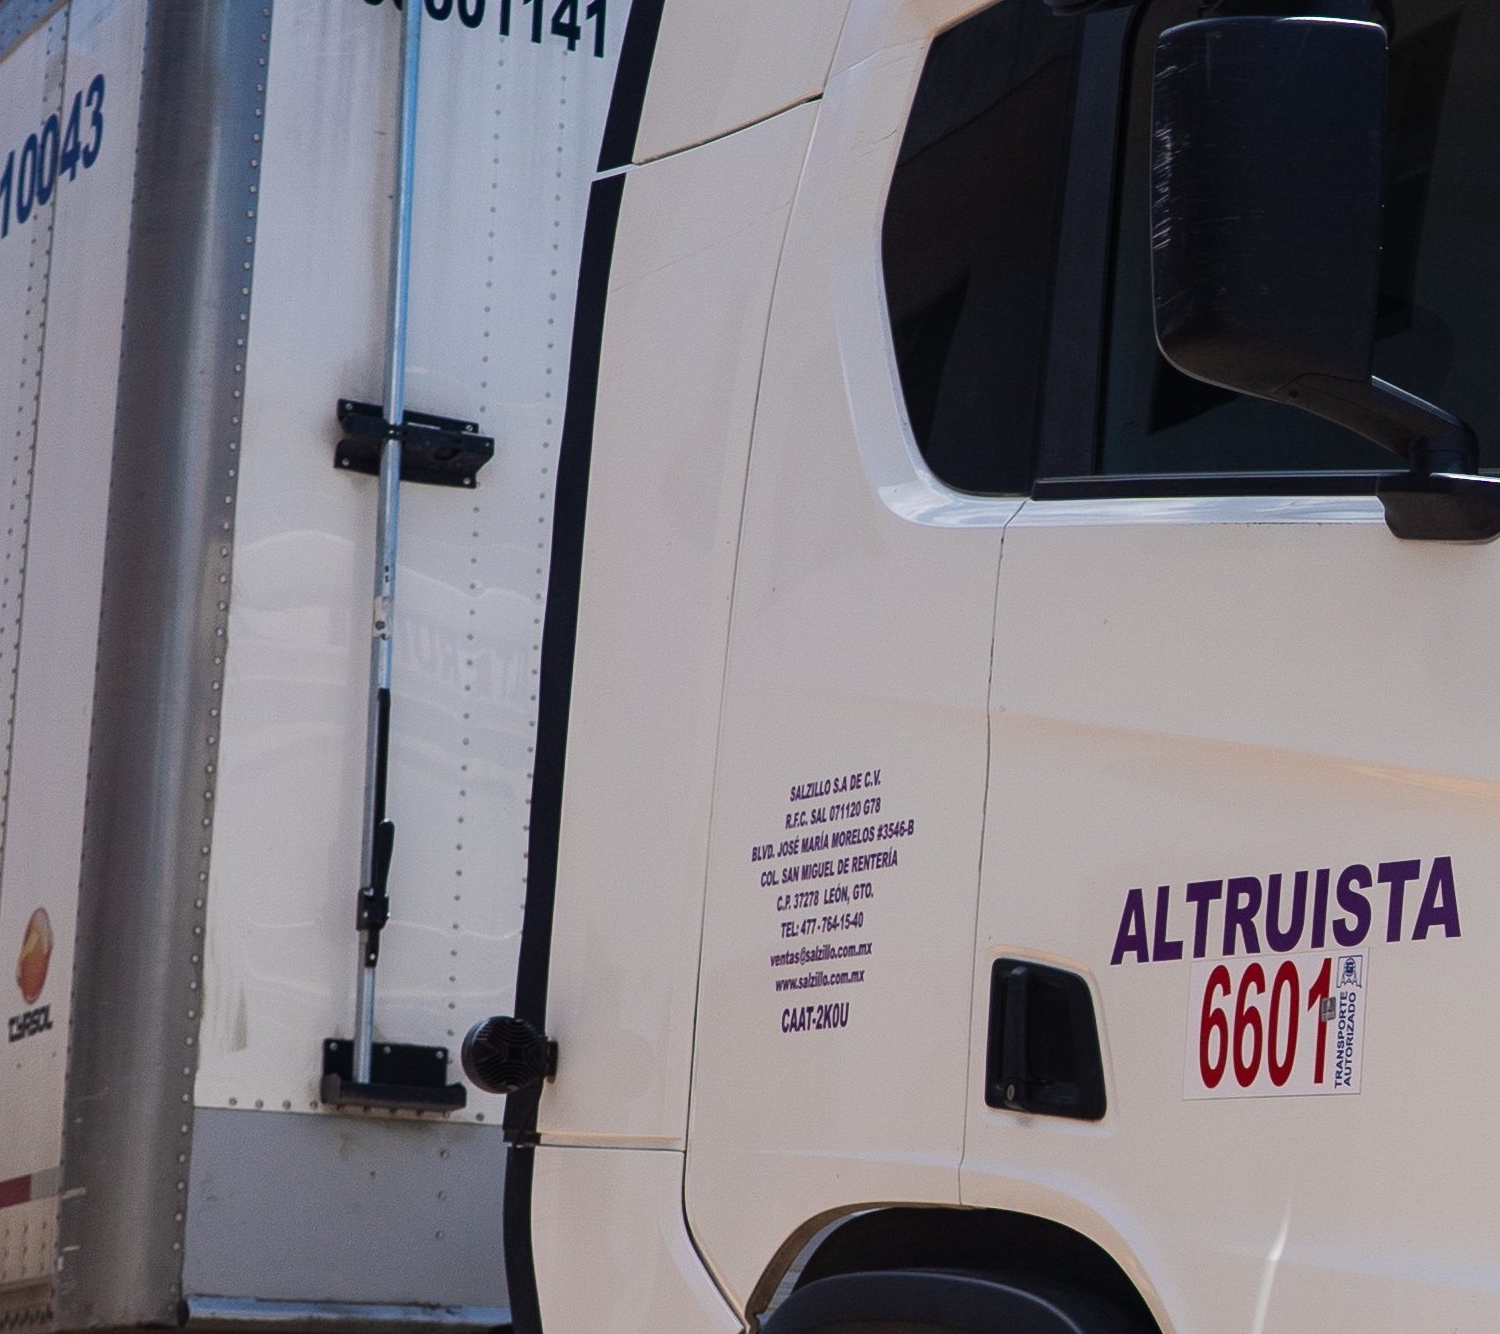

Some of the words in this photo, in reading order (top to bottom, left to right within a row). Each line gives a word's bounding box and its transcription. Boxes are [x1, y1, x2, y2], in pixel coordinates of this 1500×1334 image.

[789, 779, 831, 802] SALZILLO
[849, 772, 862, 791] DE
[864, 769, 881, 788] C.V.
[785, 810, 808, 830] R.F.C.
[810, 807, 827, 825] SAL
[829, 800, 861, 822] 071120
[863, 797, 881, 815] G78
[751, 844, 775, 862] BLVD.
[777, 835, 800, 857] JOSÉ
[801, 831, 829, 853] MARÍA
[831, 826, 875, 848] MORELOS
[781, 866, 800, 884] SAN
[801, 860, 835, 881] MIGUEL
[837, 857, 850, 875] DE
[851, 846, 898, 873] RENTERÍA
[776, 895, 792, 911] C.P.
[793, 890, 819, 909] 37278
[824, 883, 850, 906] LEÓN,
[852, 882, 874, 900] GTO.
[1110, 856, 1461, 965] ALTRUISTA
[781, 920, 799, 938] TEL:
[800, 917, 817, 935] 477
[770, 942, 873, 967] ventas@salzillo.com.mx
[775, 970, 865, 992] www.salzillo.com.mx
[1199, 957, 1332, 1089] 6601
[1334, 991, 1348, 1088] TRANSPORTE
[1343, 992, 1357, 1087] AUTORIZADO
